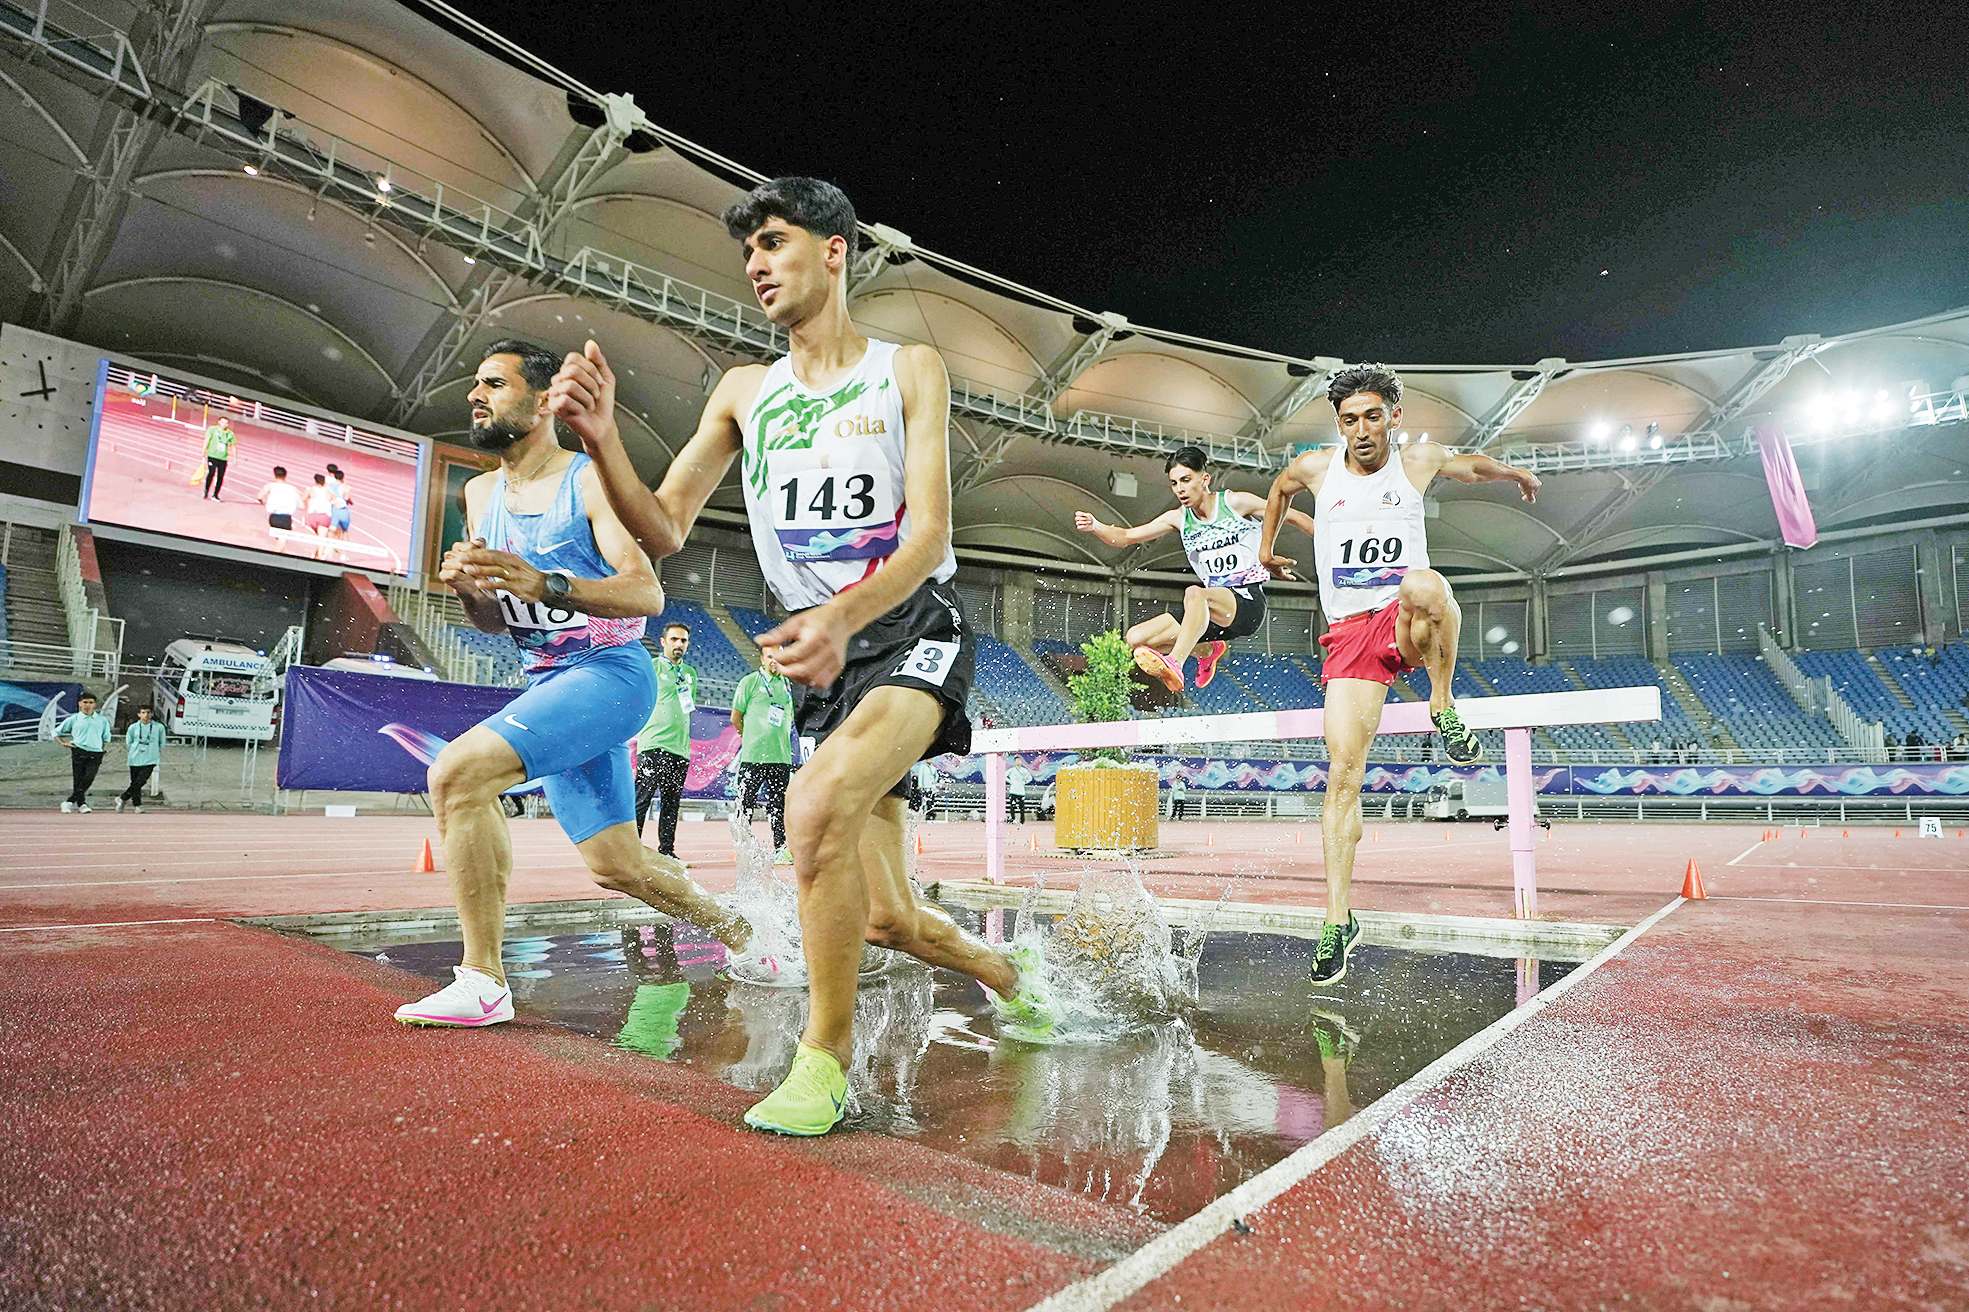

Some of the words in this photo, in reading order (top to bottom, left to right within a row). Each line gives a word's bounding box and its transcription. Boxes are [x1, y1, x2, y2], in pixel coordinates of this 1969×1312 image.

[834, 414, 887, 438] Oila
[780, 473, 875, 521] 143
[1340, 537, 1402, 564] 169
[1205, 554, 1238, 574] 199
[915, 647, 944, 673] 3
[1926, 824, 1937, 833] 75
